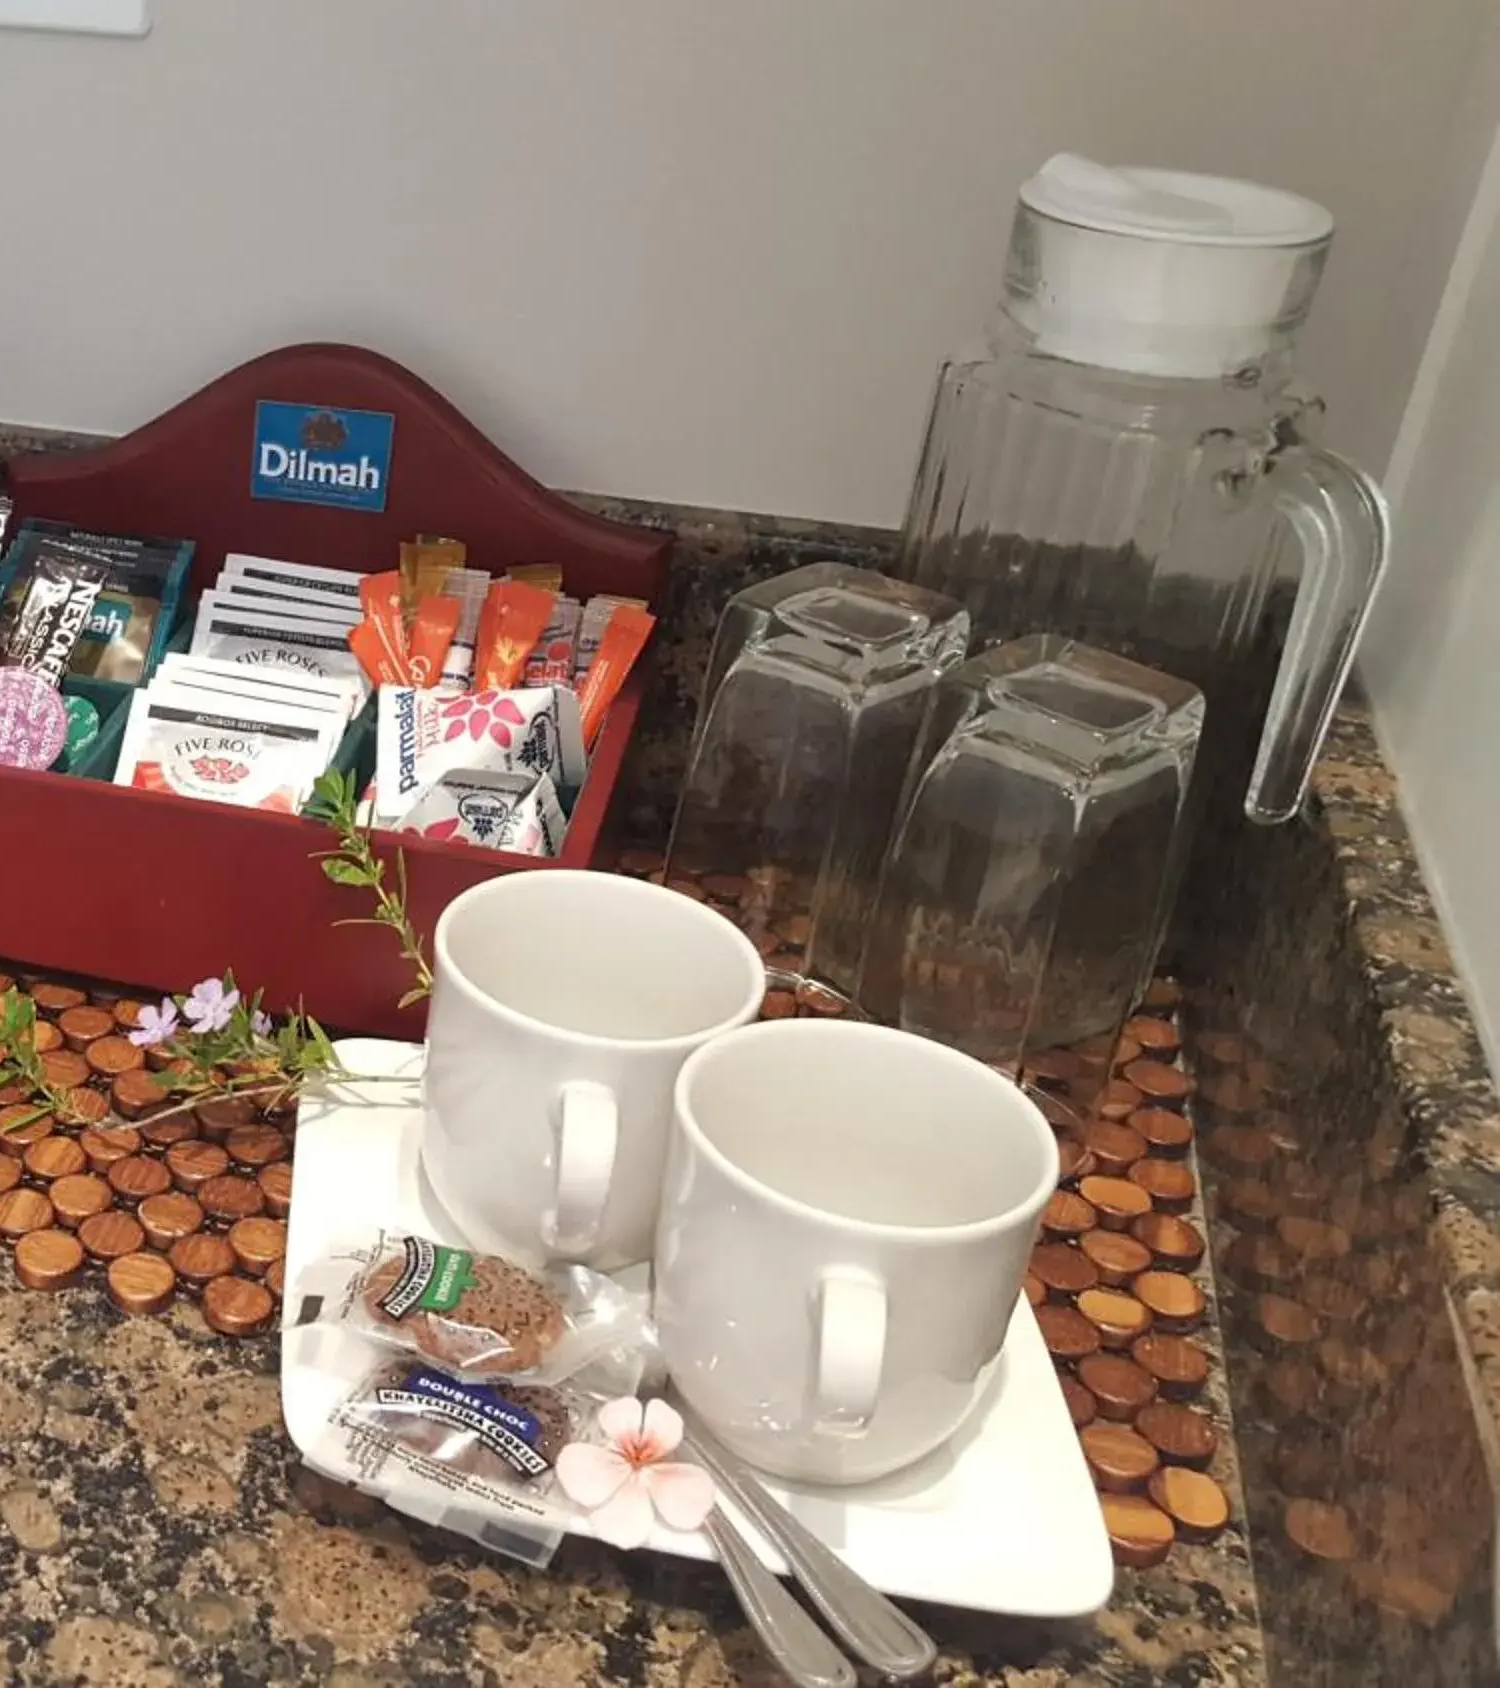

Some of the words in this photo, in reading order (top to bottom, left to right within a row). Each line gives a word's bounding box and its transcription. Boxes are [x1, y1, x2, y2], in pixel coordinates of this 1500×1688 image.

[260, 443, 380, 489] Dilmah
[21, 600, 59, 669] LASSIC
[174, 737, 213, 757] FIVE
[218, 737, 262, 760] ROS
[395, 690, 420, 795] parmalat
[382, 1390, 484, 1427] KHAYELITSHA
[486, 1424, 542, 1470] COOKIES
[417, 1377, 482, 1408] DOUBLE
[484, 1404, 530, 1431] CHOC
